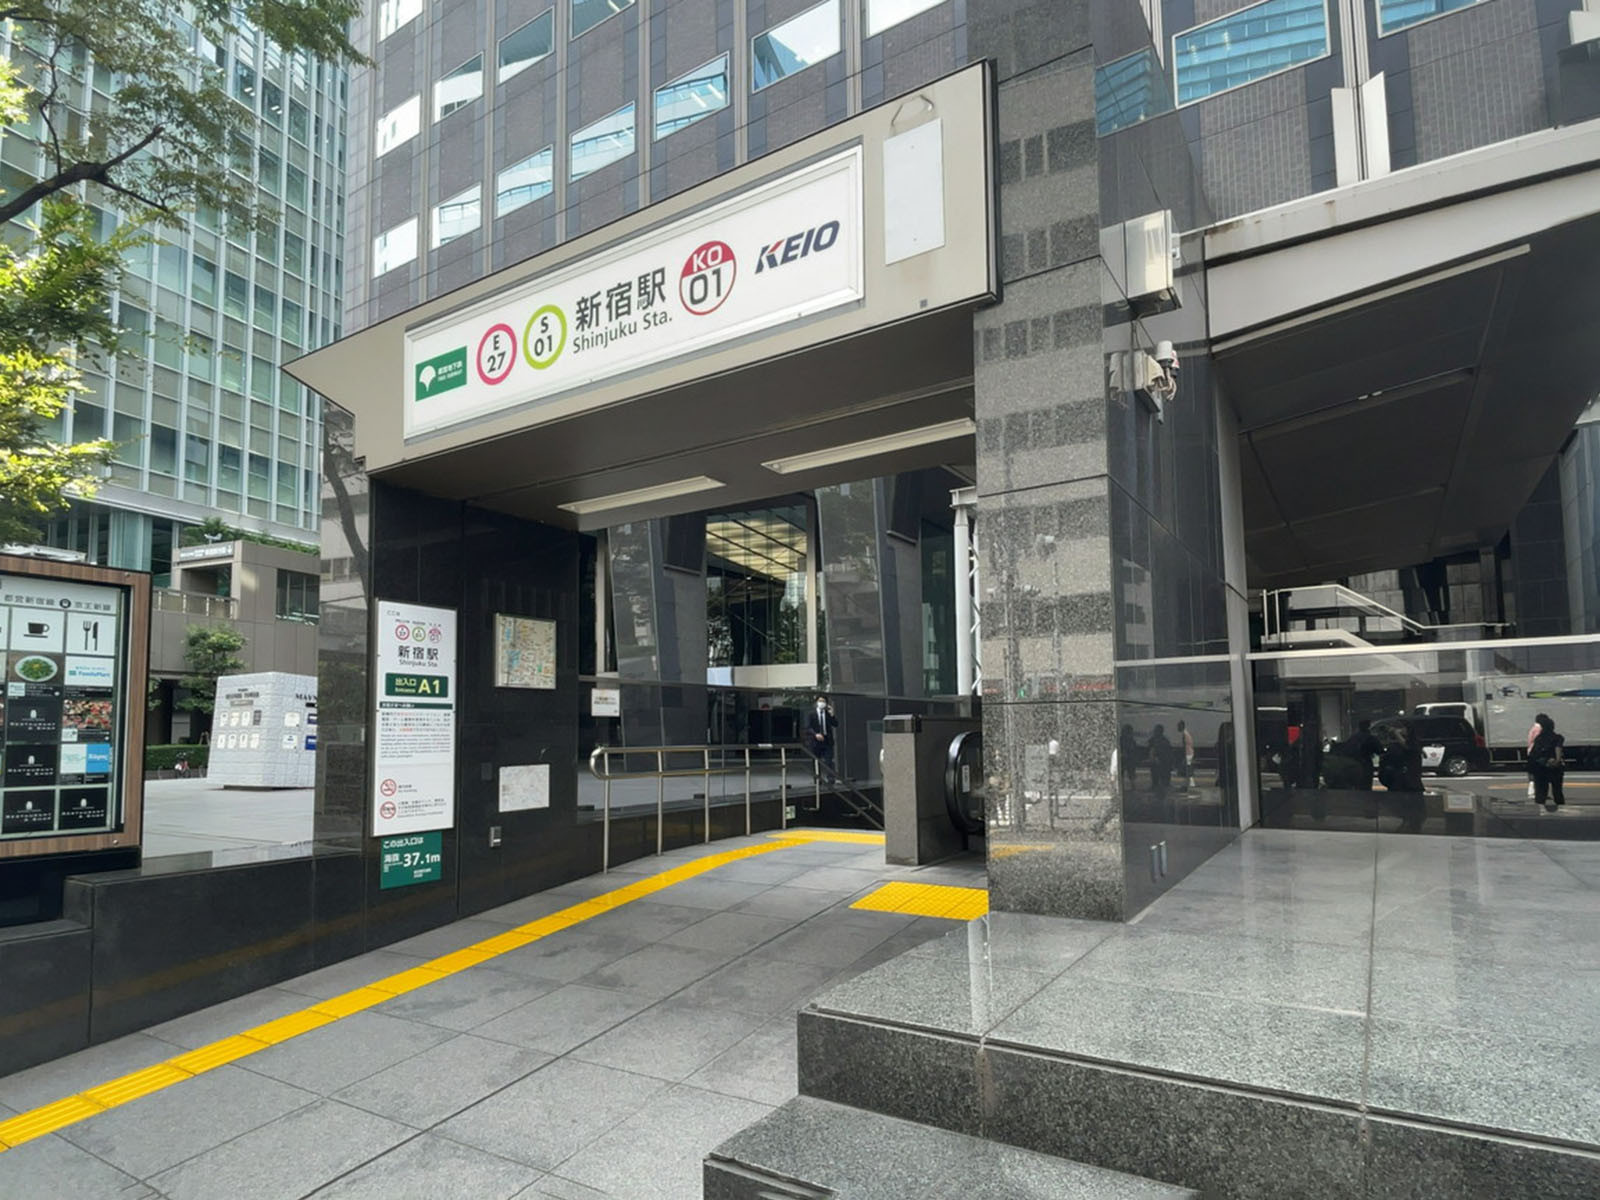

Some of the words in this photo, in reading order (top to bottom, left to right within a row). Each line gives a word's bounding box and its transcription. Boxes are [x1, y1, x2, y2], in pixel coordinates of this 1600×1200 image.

[692, 244, 723, 273] KO
[755, 220, 841, 275] KEIO
[689, 267, 721, 305] 01
[575, 267, 666, 332] 新宿駅
[540, 316, 549, 334] S
[573, 321, 637, 354] Shinjuku
[643, 310, 673, 330] Sta.
[493, 334, 500, 351] E
[534, 335, 552, 357] 01
[487, 352, 506, 374] 27
[398, 645, 439, 660] 新宿駅
[395, 677, 417, 686] 出入口
[418, 678, 441, 694] A1
[402, 851, 441, 868] 37.1m
